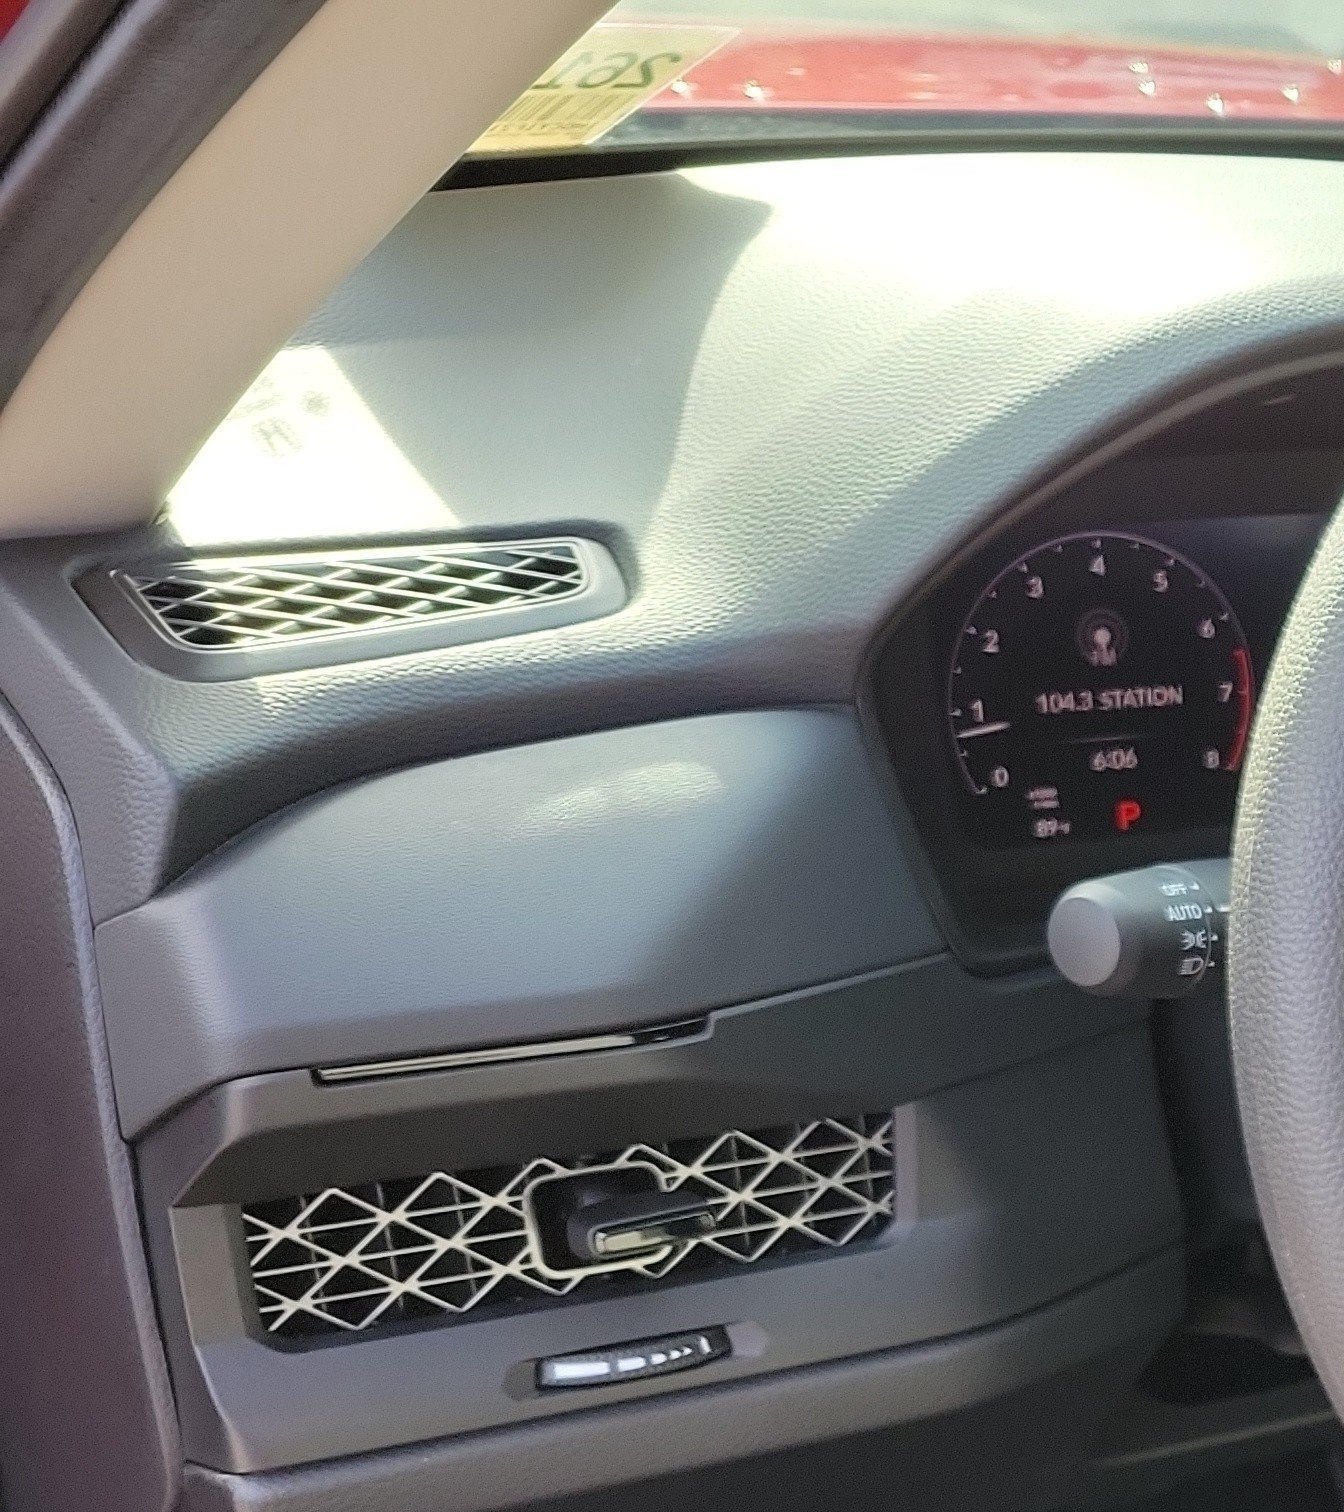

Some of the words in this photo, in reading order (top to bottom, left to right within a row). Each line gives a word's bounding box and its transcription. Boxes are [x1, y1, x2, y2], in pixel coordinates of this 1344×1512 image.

[1090, 556, 1107, 576] 4
[1026, 577, 1044, 599] 3
[1153, 570, 1169, 593] 5
[1201, 618, 1216, 639] 6
[983, 630, 999, 653] 2
[1099, 685, 1183, 712] STATION
[1219, 682, 1233, 702] 7
[970, 702, 985, 722] 1
[1090, 747, 1139, 772] 6:06
[991, 765, 1010, 788] 0
[1116, 799, 1141, 831] P
[1165, 903, 1203, 922] AUTO
